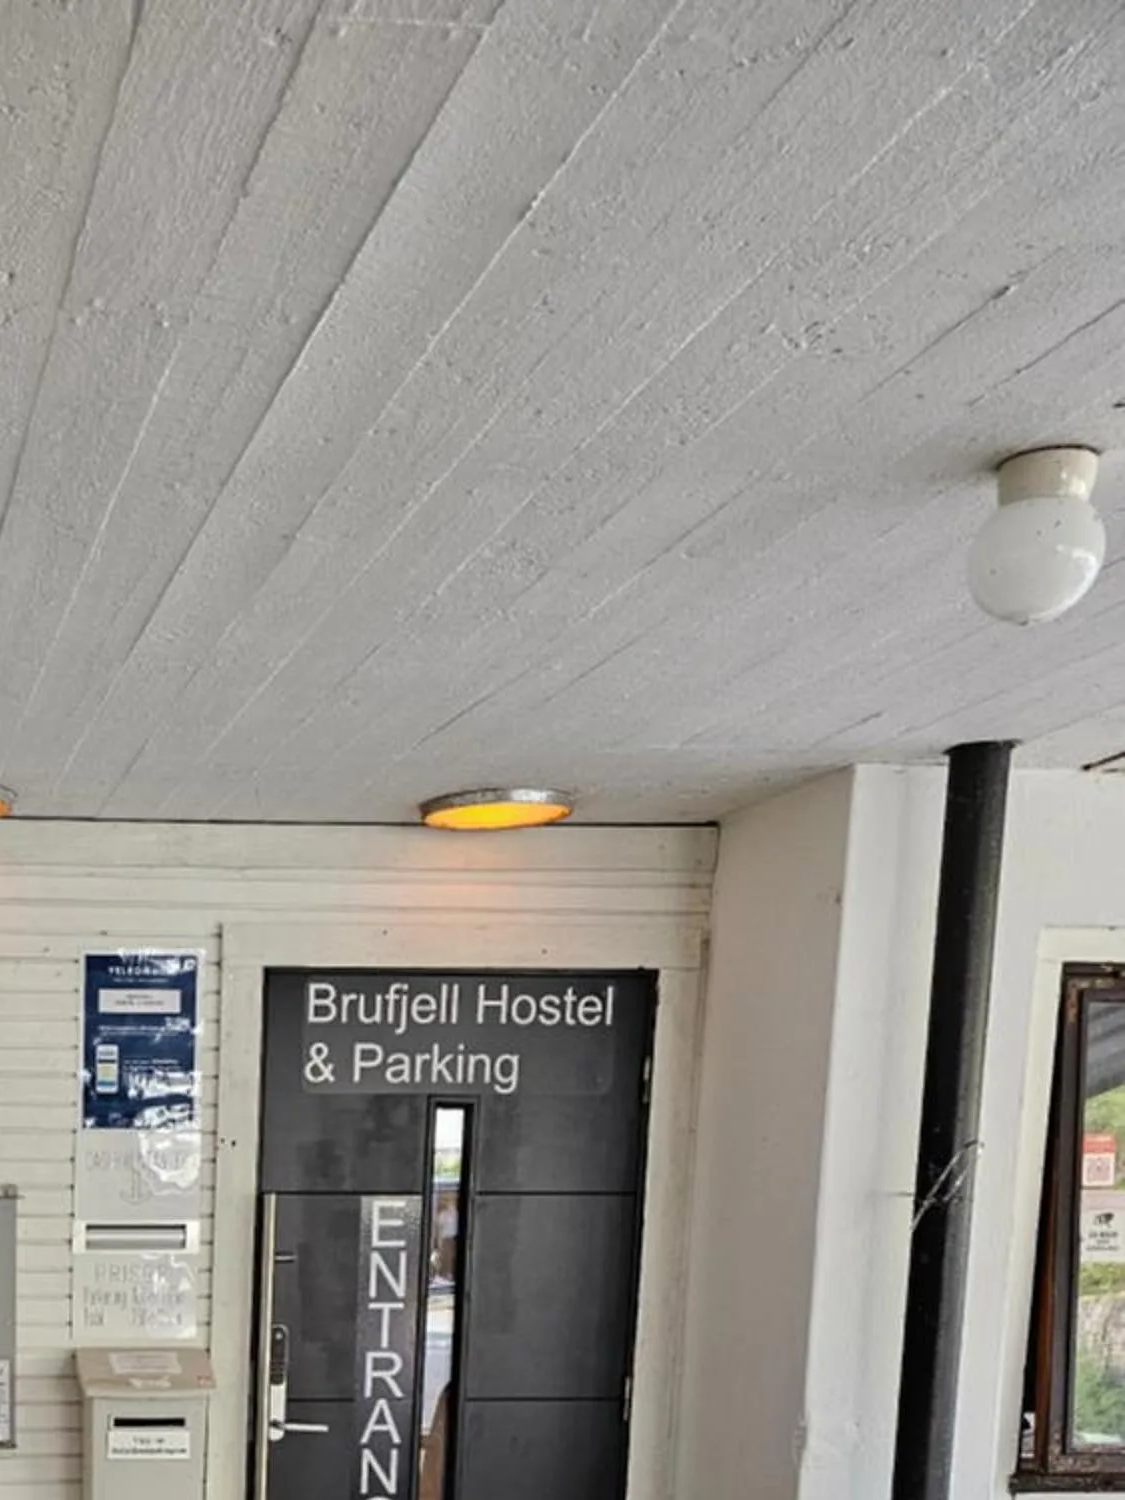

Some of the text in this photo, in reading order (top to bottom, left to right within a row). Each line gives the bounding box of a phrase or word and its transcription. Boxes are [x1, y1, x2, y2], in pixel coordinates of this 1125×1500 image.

[307, 983, 613, 1035] Brufjell Hostel
[304, 1043, 520, 1094] & Parking
